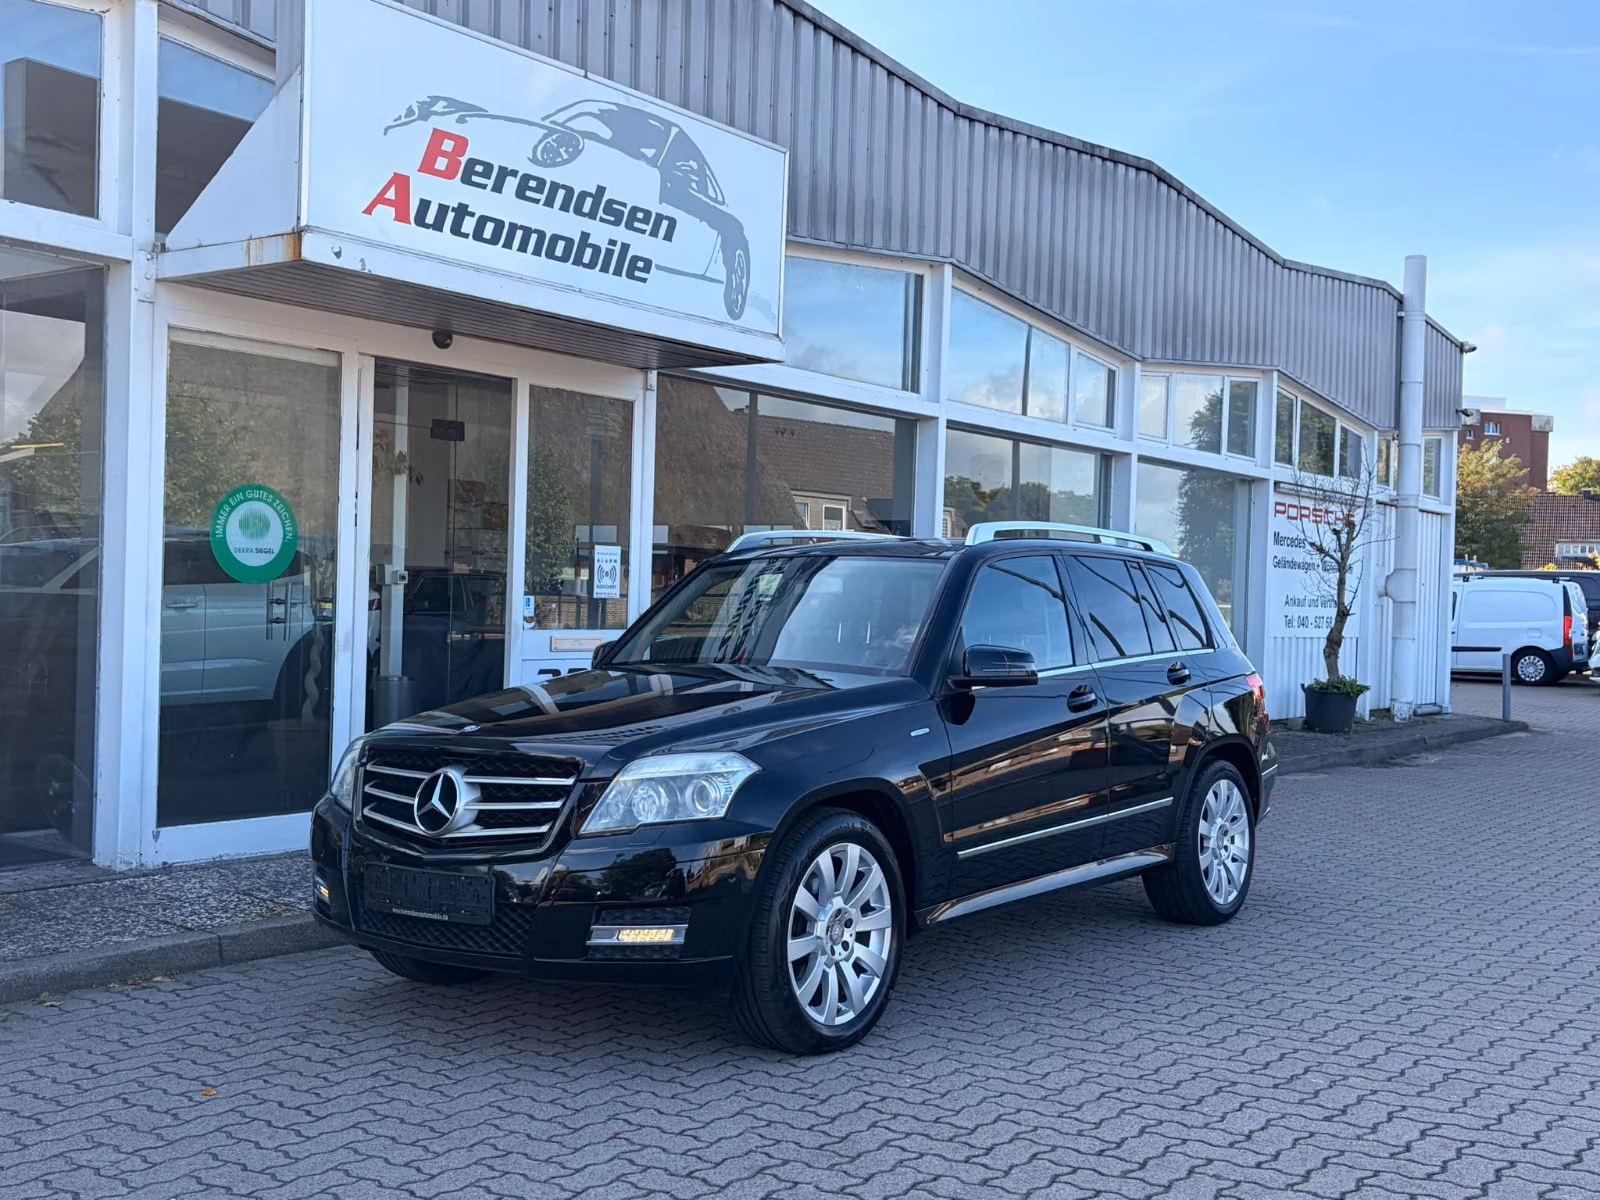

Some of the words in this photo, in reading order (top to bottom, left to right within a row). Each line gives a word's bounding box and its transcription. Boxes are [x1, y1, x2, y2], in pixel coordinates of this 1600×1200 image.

[417, 127, 677, 242] Berendsen
[361, 171, 654, 284] Automobile
[215, 504, 231, 538] IMMER
[229, 492, 244, 505] EIN
[245, 489, 273, 503] GUTES
[1273, 531, 1307, 549] Mercedes
[234, 546, 254, 554] DEKRA
[254, 547, 275, 555] SIEGEL
[1272, 555, 1316, 574] Geländewagen
[1284, 594, 1307, 608] Ankauf
[1307, 596, 1320, 609] und
[1284, 615, 1296, 629] Tel:
[1297, 615, 1309, 629] 040
[1314, 616, 1325, 630] 527
